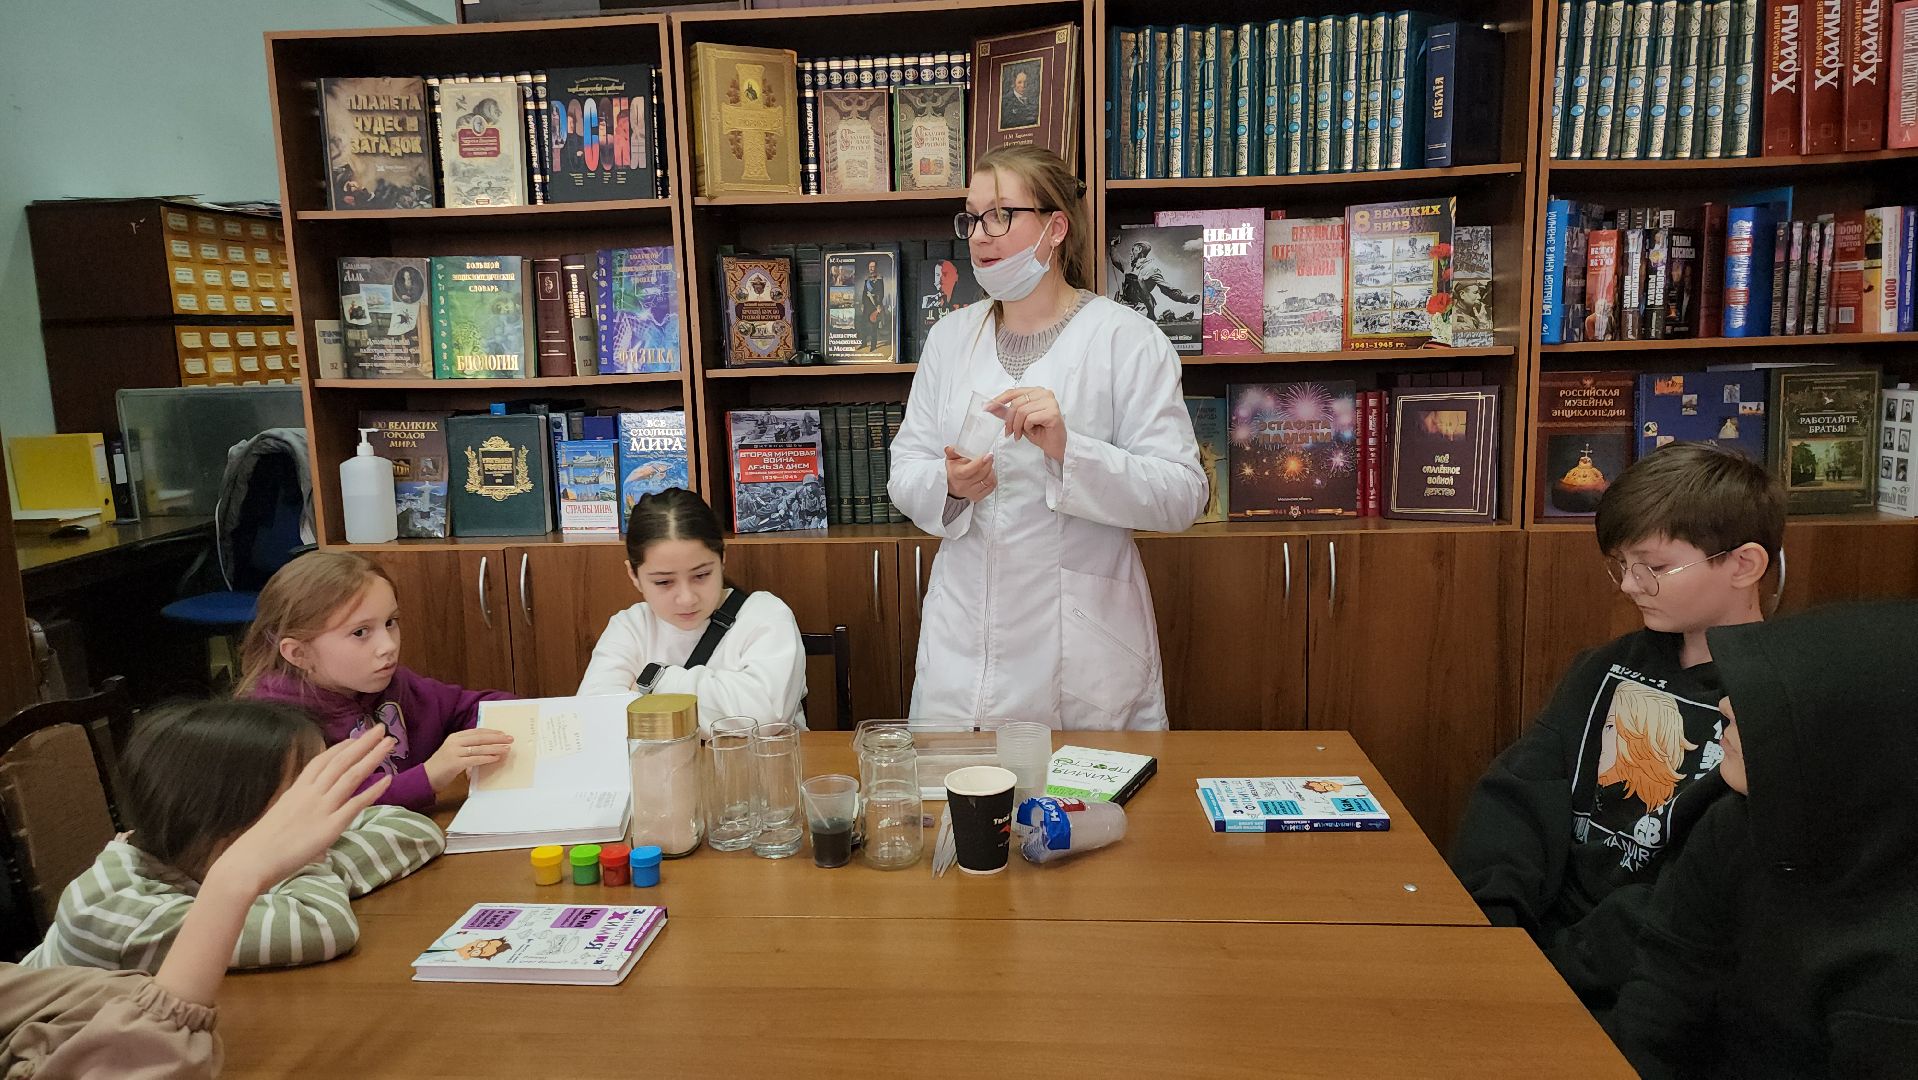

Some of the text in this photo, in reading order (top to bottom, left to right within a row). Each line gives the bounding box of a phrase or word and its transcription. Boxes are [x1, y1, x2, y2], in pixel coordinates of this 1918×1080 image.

[1853, 0, 1862, 63] ПРАВОСЛАВНЫ
[1771, 4, 1801, 95] Храмы
[1814, 0, 1845, 91] Храмы
[348, 94, 421, 110] ПЛАНЕТА
[353, 115, 419, 134] ЧУДЕС И
[351, 137, 423, 156] ЗАГАДОК
[1354, 205, 1442, 233] 8 ВЕЛИКИХ
[1373, 220, 1410, 233] БИТВ
[466, 261, 500, 269] БОЛЬШОЙ
[619, 348, 674, 363] ФИЗИКА
[457, 355, 520, 371] БИОЛОГИЯ
[1559, 386, 1620, 397] РОССИЙСКАЯ
[1564, 397, 1614, 407] МУЗЕЙНАЯ
[1551, 409, 1626, 418] ЭНЦИКЛОПЕДИЯ
[1799, 414, 1860, 425] РАБОТАЙТЕ,
[388, 421, 438, 430] ВЕЛИКИХ
[1258, 419, 1332, 431] ЭСТАФЕТА
[1809, 425, 1847, 434] БРАТЬЯ!
[630, 428, 684, 437] СТОЛИЦЫ
[1258, 431, 1333, 444] ПАМЯТИ
[630, 437, 686, 451] МИРА
[565, 504, 613, 514] СТРАНЫ МИРА
[1052, 767, 1119, 784] ХИМИЯ
[574, 909, 601, 928] Чем
[584, 911, 630, 950] ХИМИЯ
